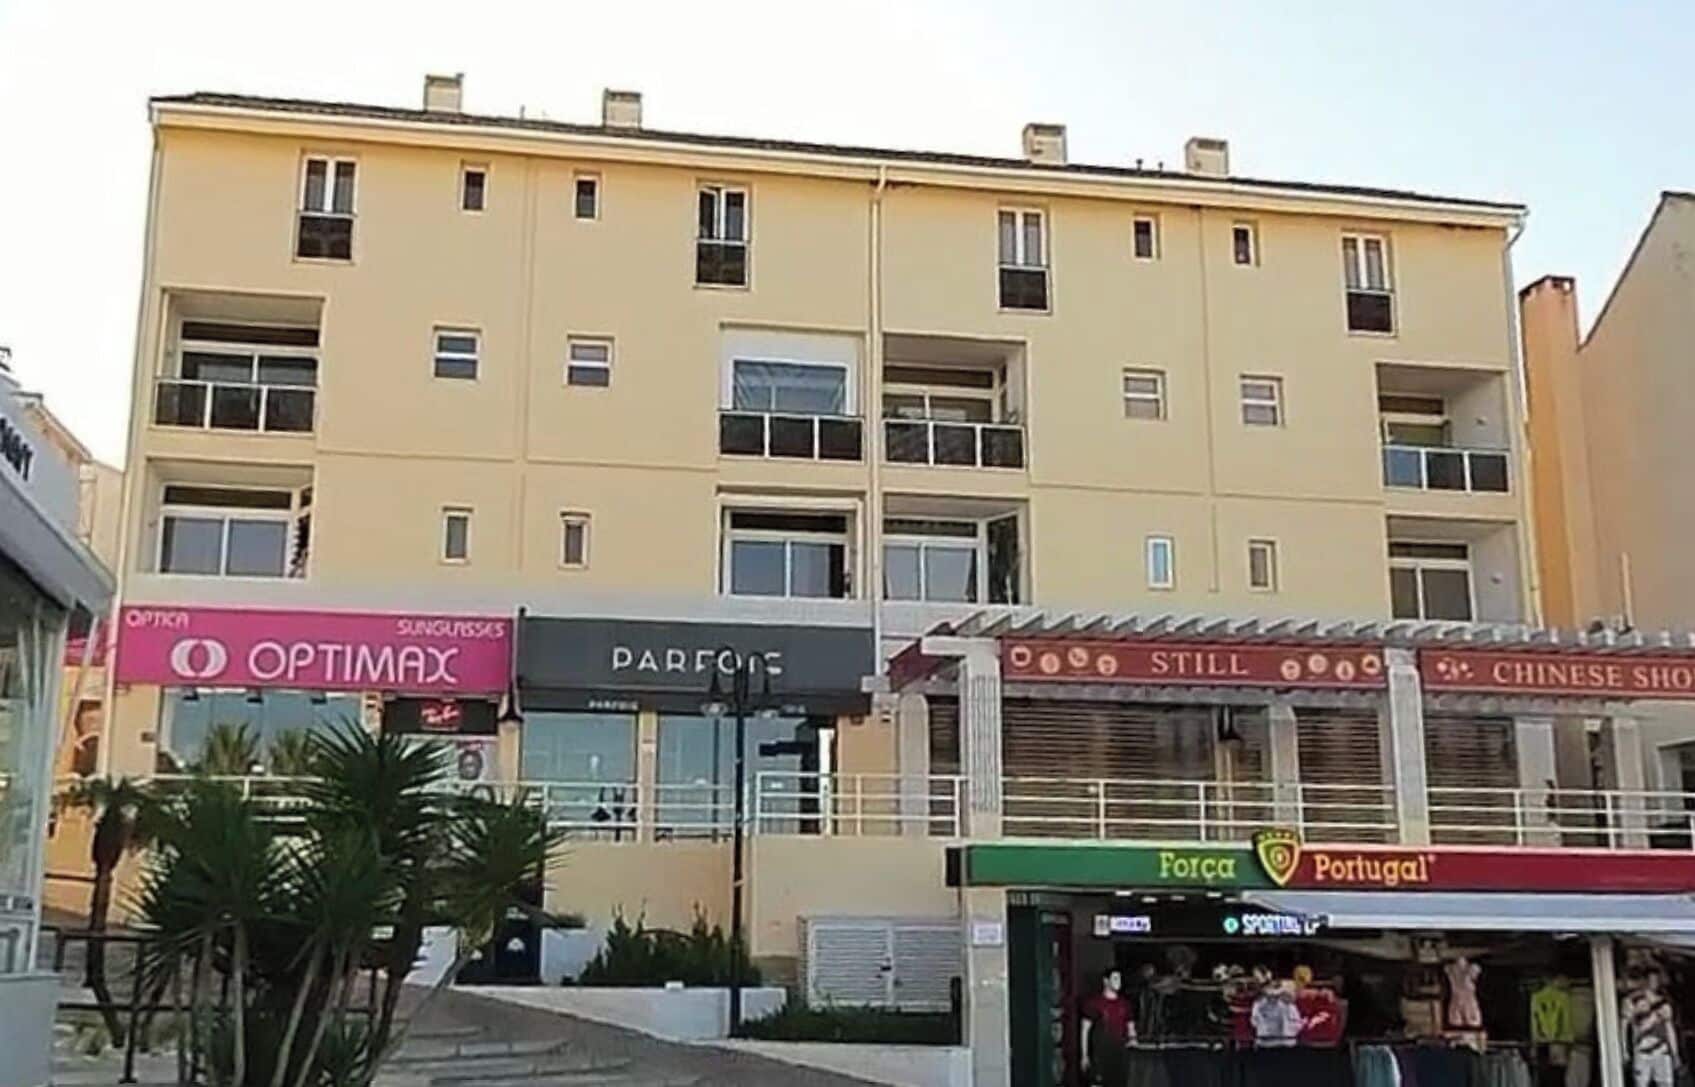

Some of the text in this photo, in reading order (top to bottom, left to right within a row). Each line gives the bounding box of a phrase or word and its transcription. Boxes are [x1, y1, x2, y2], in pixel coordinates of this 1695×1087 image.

[125, 610, 189, 628] OPTICA
[397, 619, 505, 638] SUNGLASSES
[248, 641, 459, 684] OPTIMAX
[612, 647, 783, 674] PARFOIS
[1151, 652, 1249, 675] STILL
[1493, 662, 1695, 689] CHINESE SHO
[1160, 852, 1235, 882] Força
